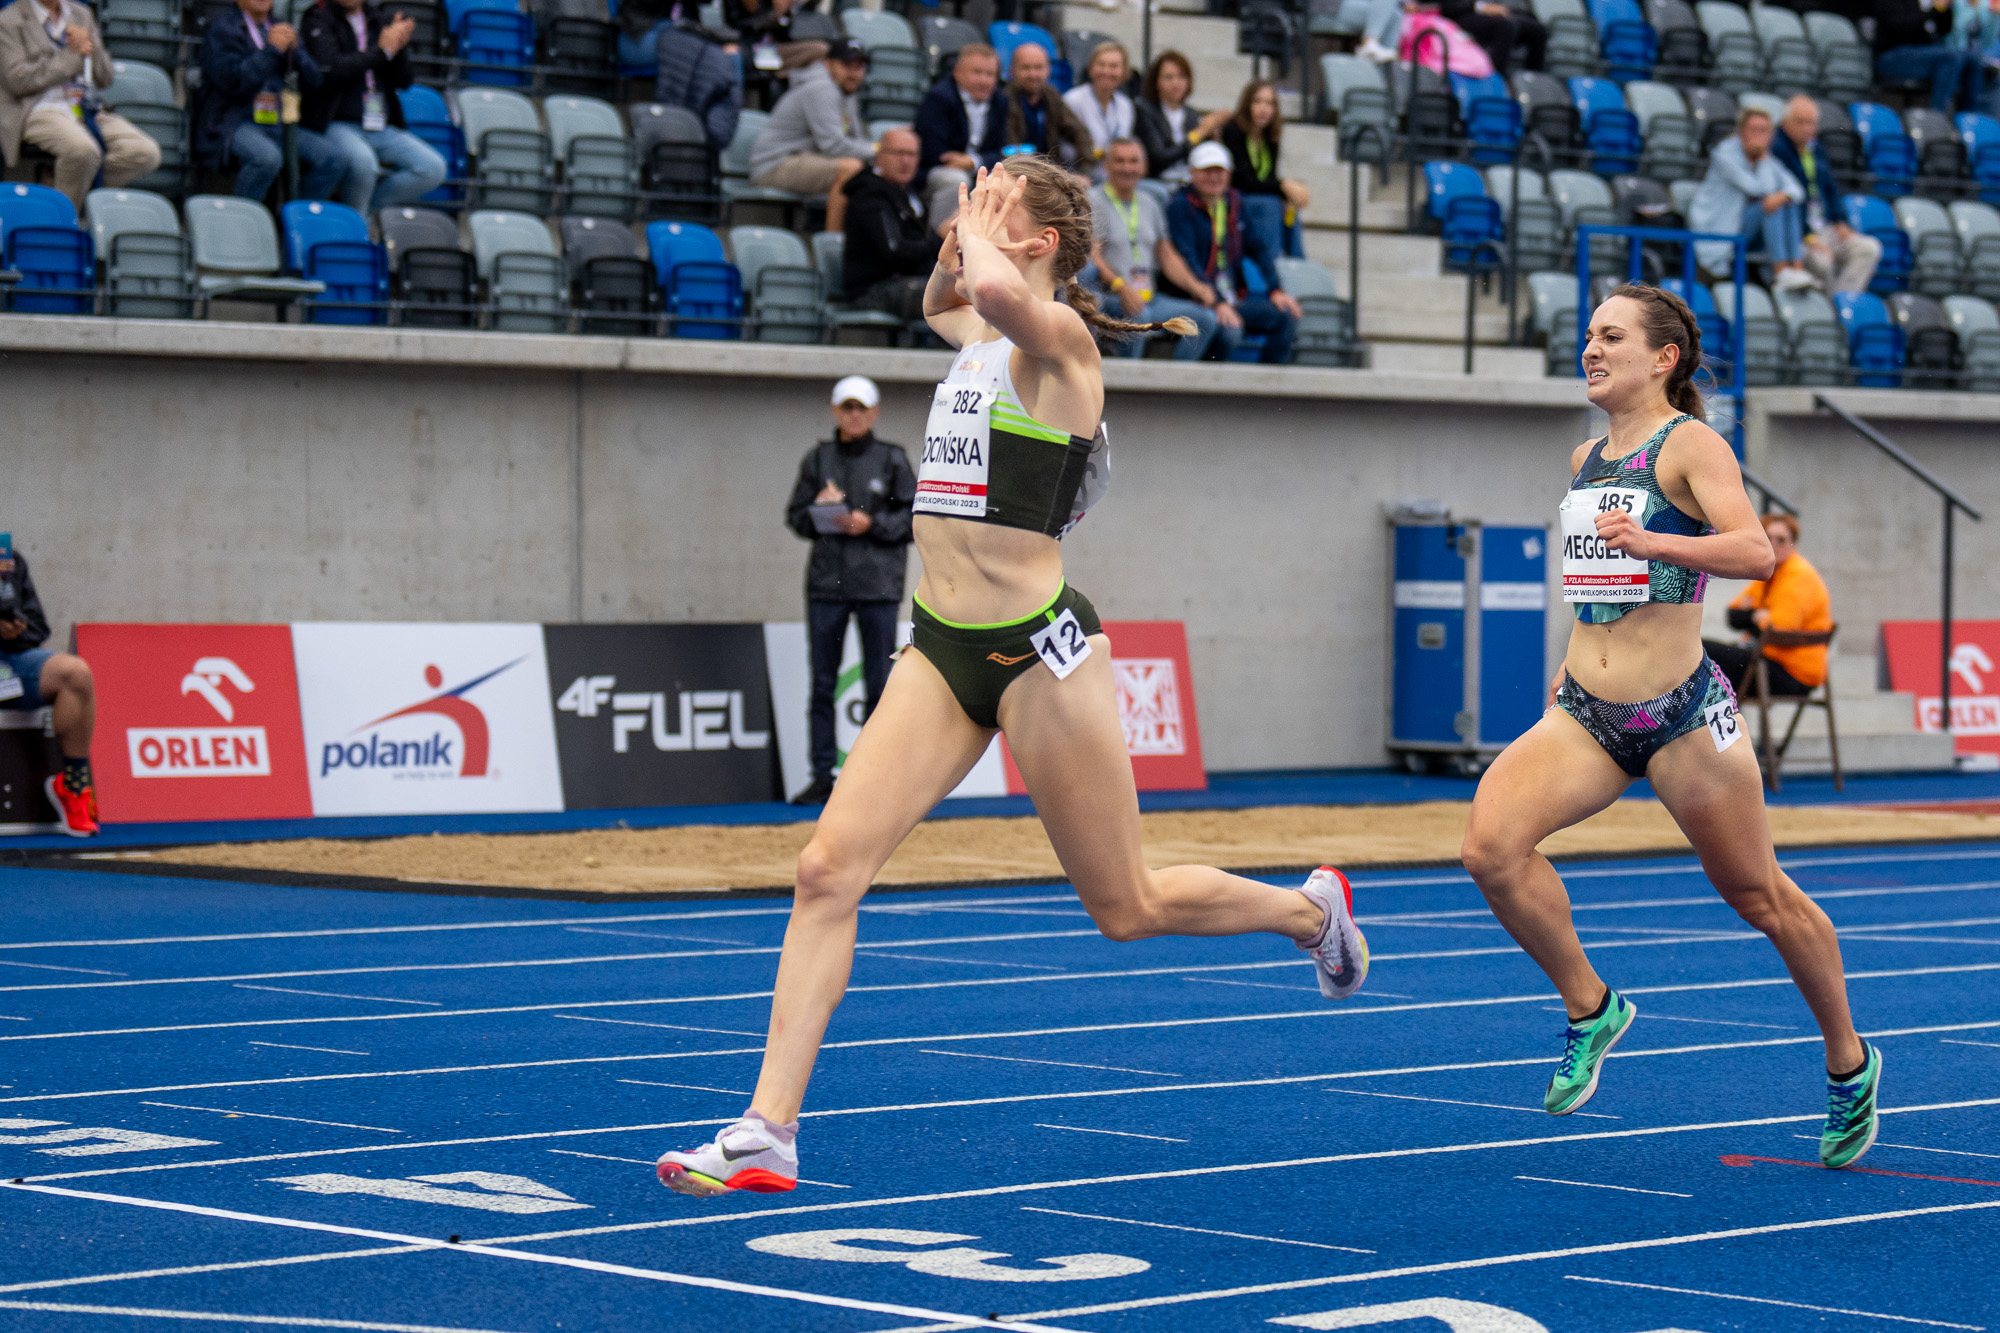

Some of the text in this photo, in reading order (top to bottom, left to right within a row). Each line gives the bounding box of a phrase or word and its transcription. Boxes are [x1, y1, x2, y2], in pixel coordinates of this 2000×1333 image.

[952, 389, 982, 415] 282
[951, 484, 970, 494] Polski
[1597, 492, 1635, 514] 485
[960, 499, 979, 508] 2023
[1563, 587, 1644, 597] ZÓW WIELKOPOLSKI 2023
[1582, 576, 1609, 585] Mistrzostwa
[1609, 576, 1632, 584] Polski
[1041, 620, 1087, 666] 12
[557, 675, 770, 753] 4F FUEL
[1708, 705, 1737, 741] 13
[1120, 723, 1184, 751] ZLA
[137, 736, 259, 769] ORLEN
[321, 731, 453, 778] polanik
[745, 1227, 1152, 1282] 3
